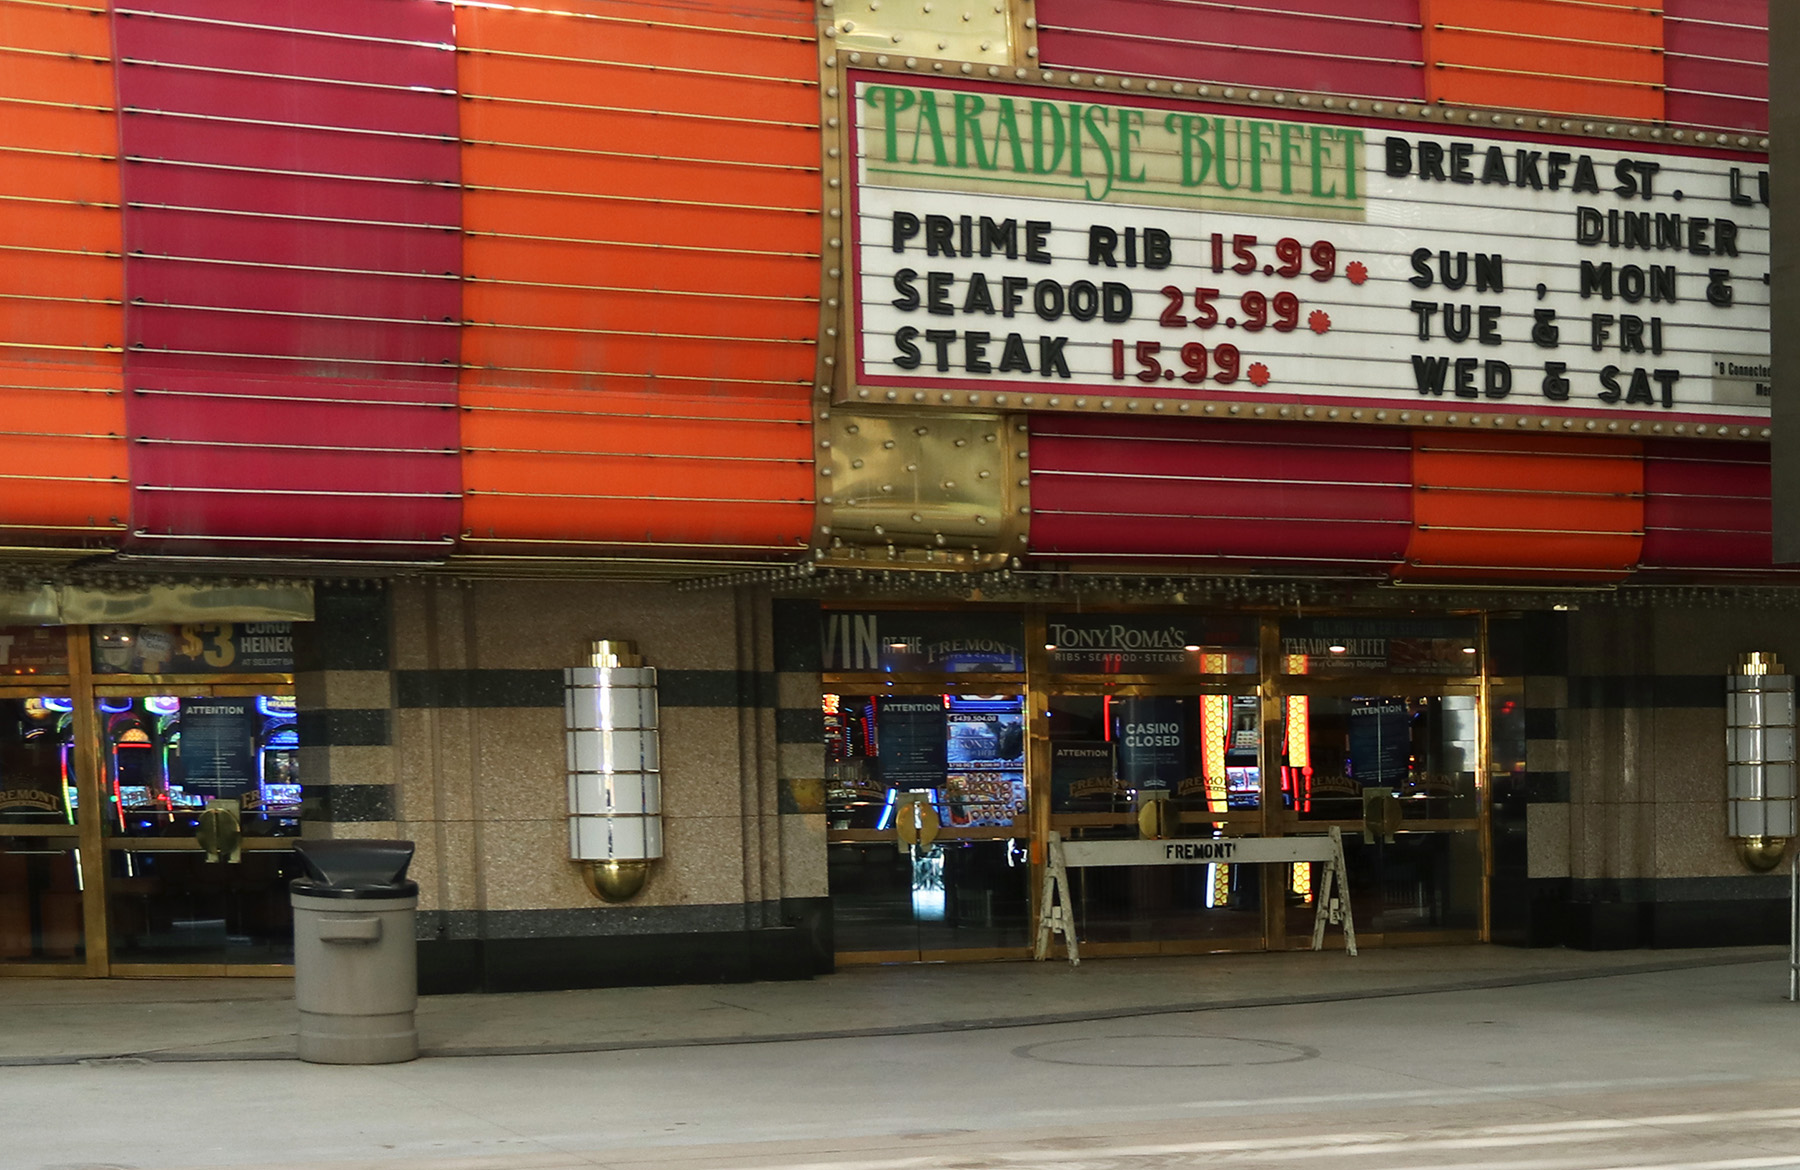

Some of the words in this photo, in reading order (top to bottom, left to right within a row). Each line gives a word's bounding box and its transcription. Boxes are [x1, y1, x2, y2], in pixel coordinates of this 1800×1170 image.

[865, 85, 1146, 201] PARADISE
[1164, 112, 1366, 200] BUFFET
[892, 211, 1053, 264] PRIME
[1088, 224, 1172, 270] RIB
[1576, 206, 1738, 257] DINNER
[891, 268, 1133, 323] SEAFOOD
[1580, 260, 1677, 304] MON
[1706, 268, 1733, 307] &
[1411, 300, 1502, 345] TUE
[1532, 308, 1559, 348] &
[1592, 313, 1663, 355] FRI
[892, 325, 1071, 378] STEAK
[1411, 355, 1512, 399] WED
[1542, 362, 1570, 401] &
[1598, 365, 1680, 408] SAT
[927, 639, 1020, 664] FREMONT
[1055, 653, 1080, 661] RIBS
[1089, 653, 1137, 662] SEAFOOD
[1144, 653, 1185, 662] STEAKS
[186, 705, 244, 715] ATTENTION
[882, 703, 941, 712] ATTENTION
[1350, 704, 1402, 716] ATTENTION
[1125, 723, 1179, 735] CASINO
[1125, 735, 1180, 747] CLOSED
[1057, 749, 1108, 757] ATTENTION
